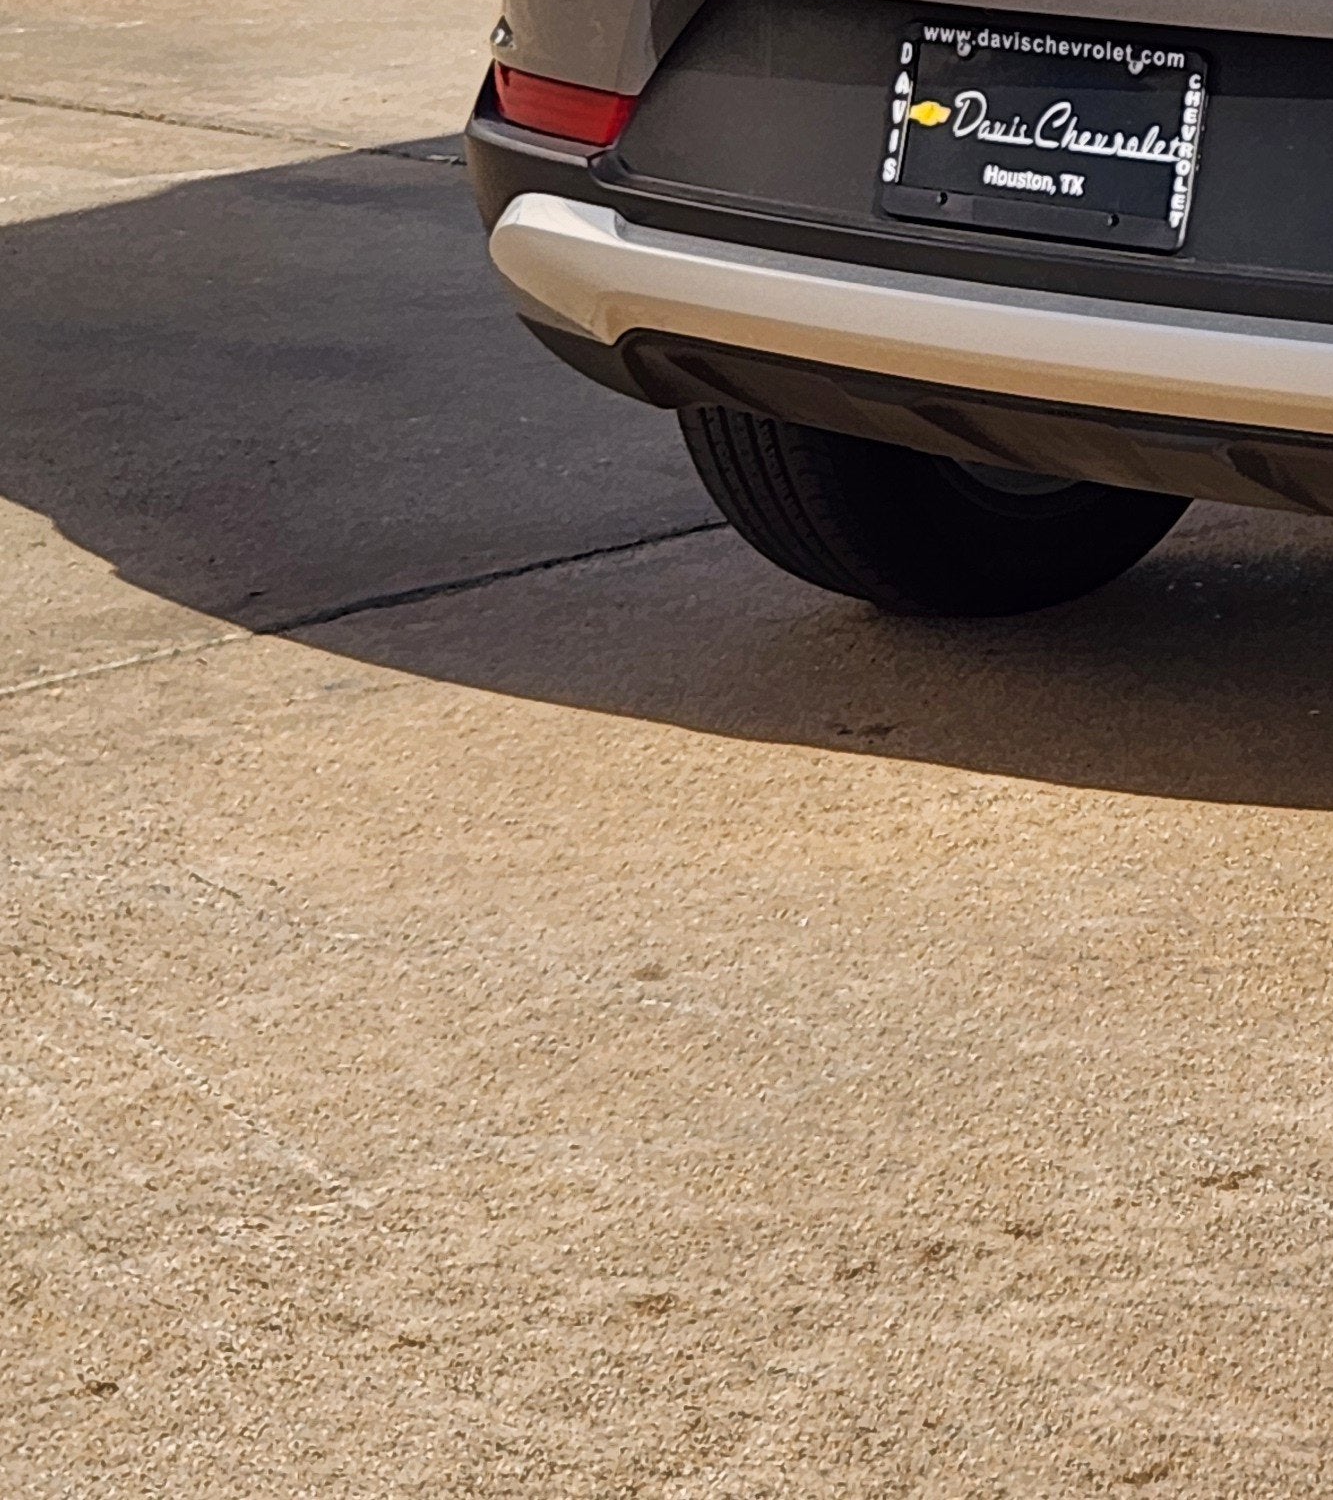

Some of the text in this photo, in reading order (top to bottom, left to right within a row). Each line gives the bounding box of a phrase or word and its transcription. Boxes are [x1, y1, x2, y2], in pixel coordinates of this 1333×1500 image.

[923, 25, 1185, 68] www.davischevroletcom
[882, 41, 913, 183] DAVIS
[953, 90, 1033, 146] Davis
[1168, 73, 1202, 228] CHEVROLET
[983, 164, 1086, 196] Houston, TX
